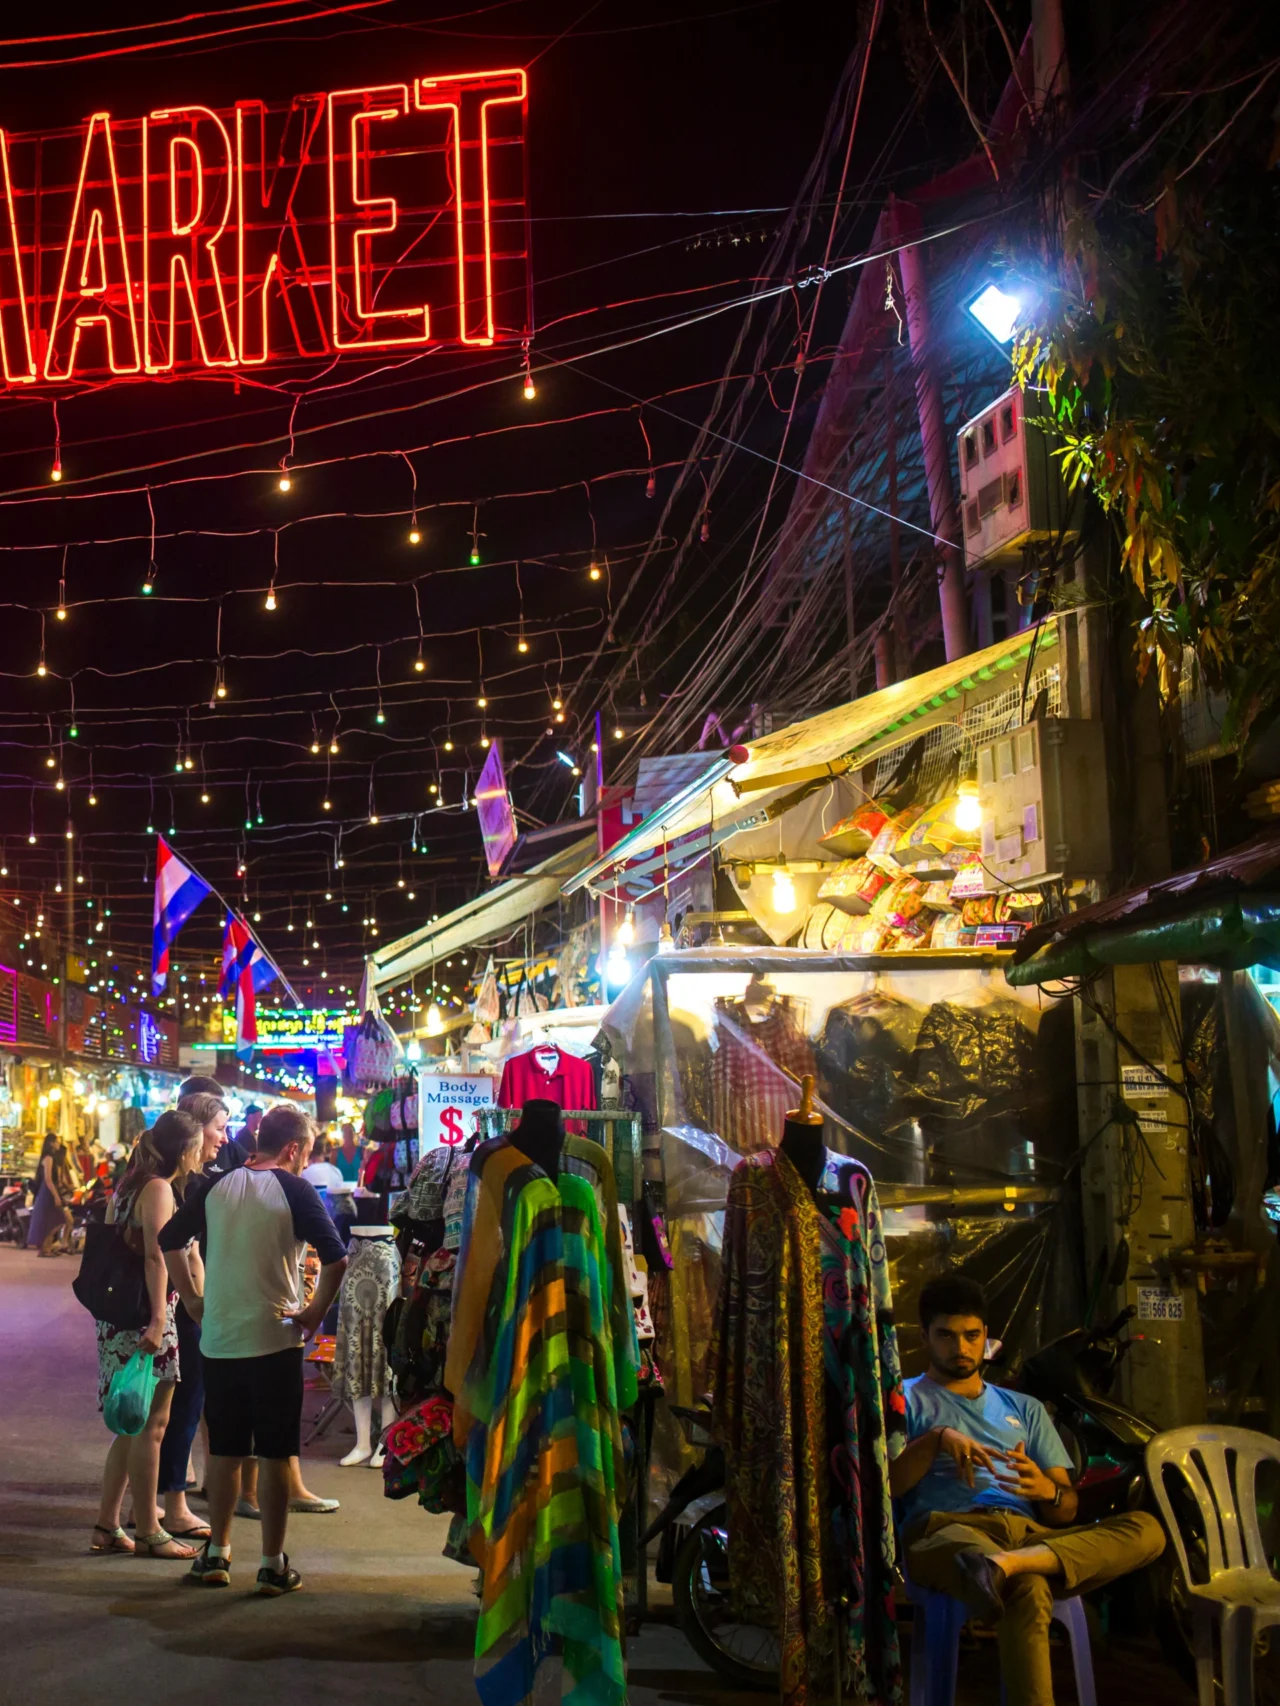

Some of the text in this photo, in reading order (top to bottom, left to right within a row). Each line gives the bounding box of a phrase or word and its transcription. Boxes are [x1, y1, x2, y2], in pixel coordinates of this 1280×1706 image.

[439, 1081, 477, 1095] Body
[427, 1092, 489, 1106] Massage
[1152, 1302, 1166, 1318] 566
[1168, 1302, 1182, 1319] 825
